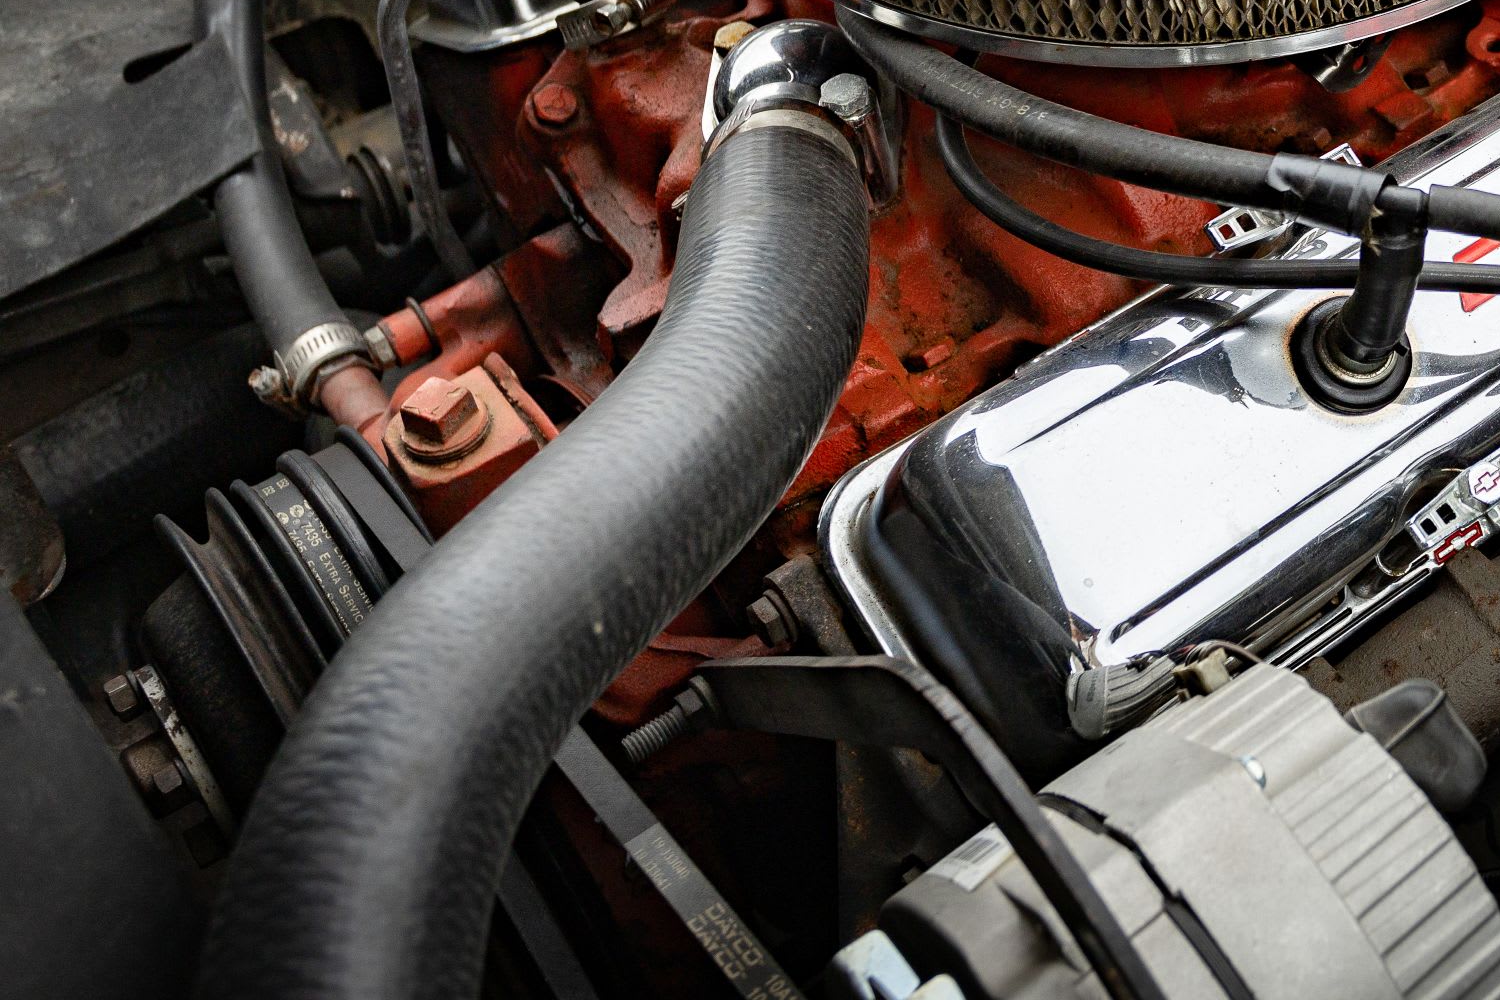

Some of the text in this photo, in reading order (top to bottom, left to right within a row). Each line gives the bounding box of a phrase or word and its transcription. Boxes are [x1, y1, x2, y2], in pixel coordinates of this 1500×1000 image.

[301, 521, 323, 547] 7435
[319, 552, 341, 585] EXTRA
[339, 584, 366, 626] SERVIC
[687, 914, 743, 980] DAYCO
[705, 902, 764, 967] DAYCO
